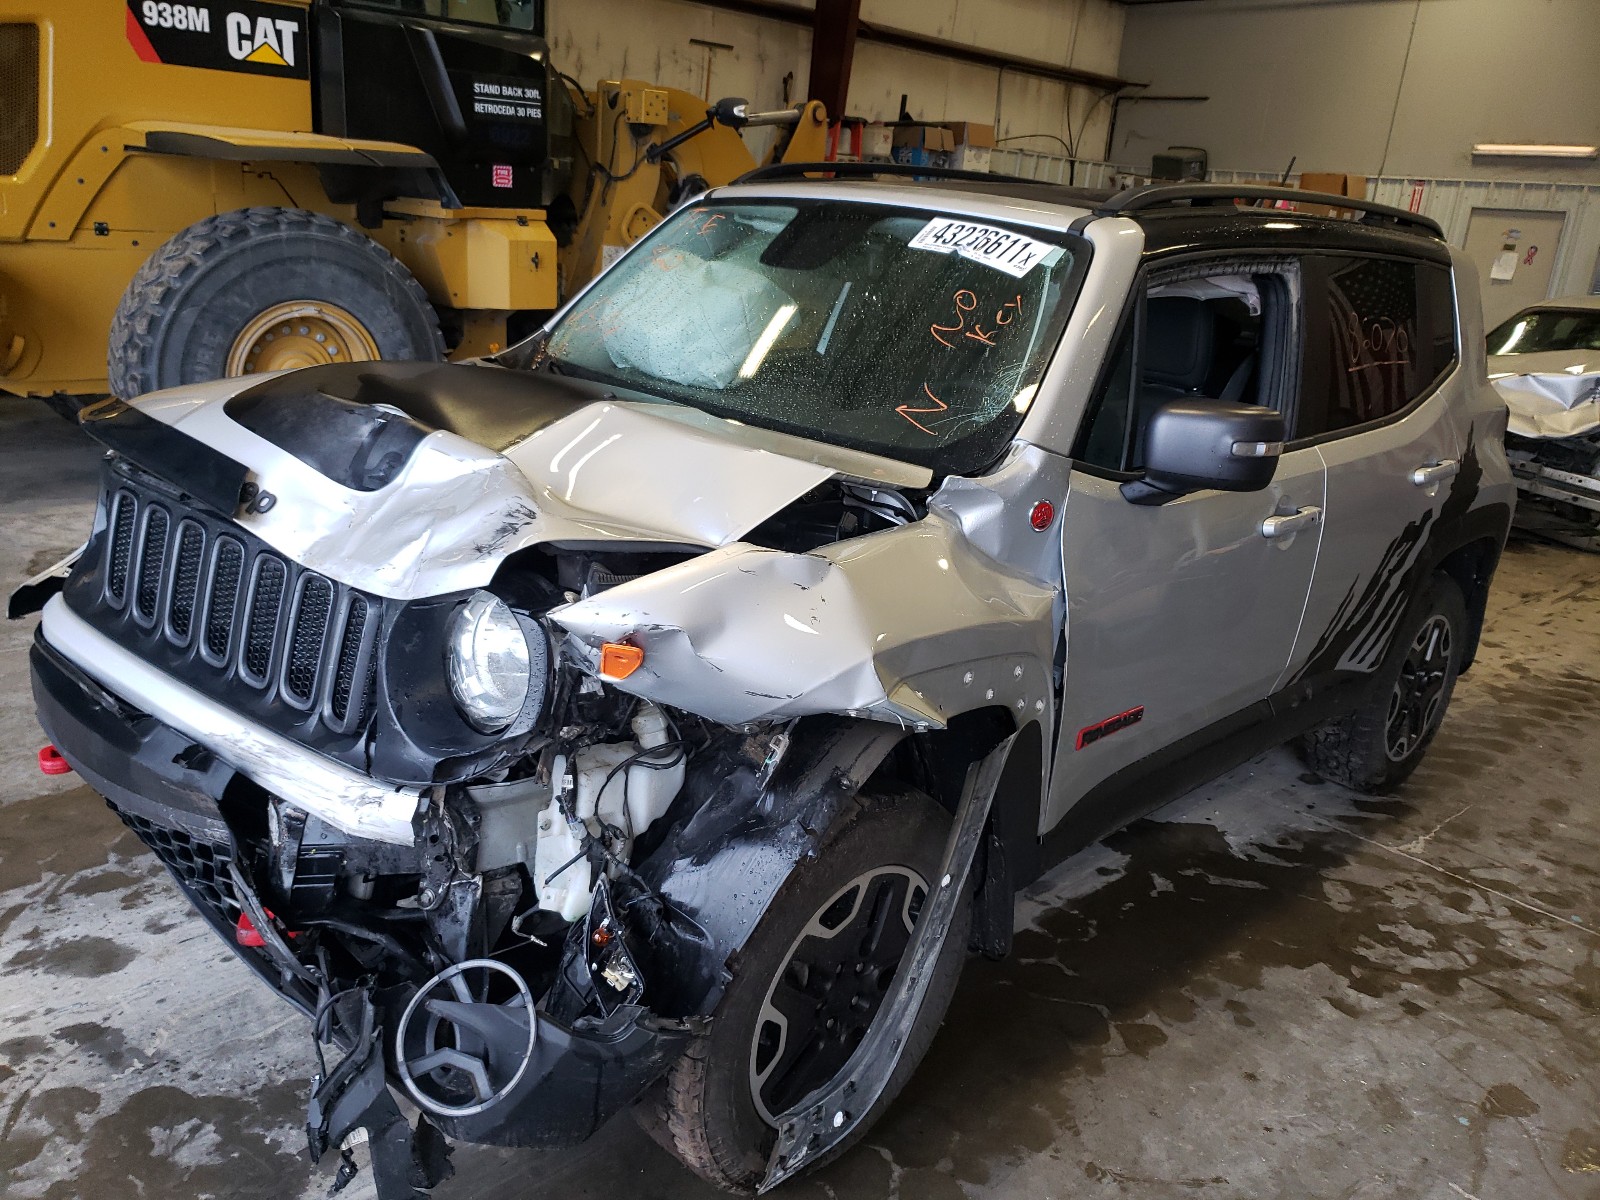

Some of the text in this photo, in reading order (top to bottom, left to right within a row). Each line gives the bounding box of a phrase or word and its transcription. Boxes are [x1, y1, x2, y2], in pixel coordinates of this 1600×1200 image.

[142, 0, 210, 33] 938M
[226, 12, 299, 67] CAT
[473, 83, 500, 95] STAND
[502, 86, 523, 98] BACK
[474, 103, 542, 118] RETROCEDA 30 PIES
